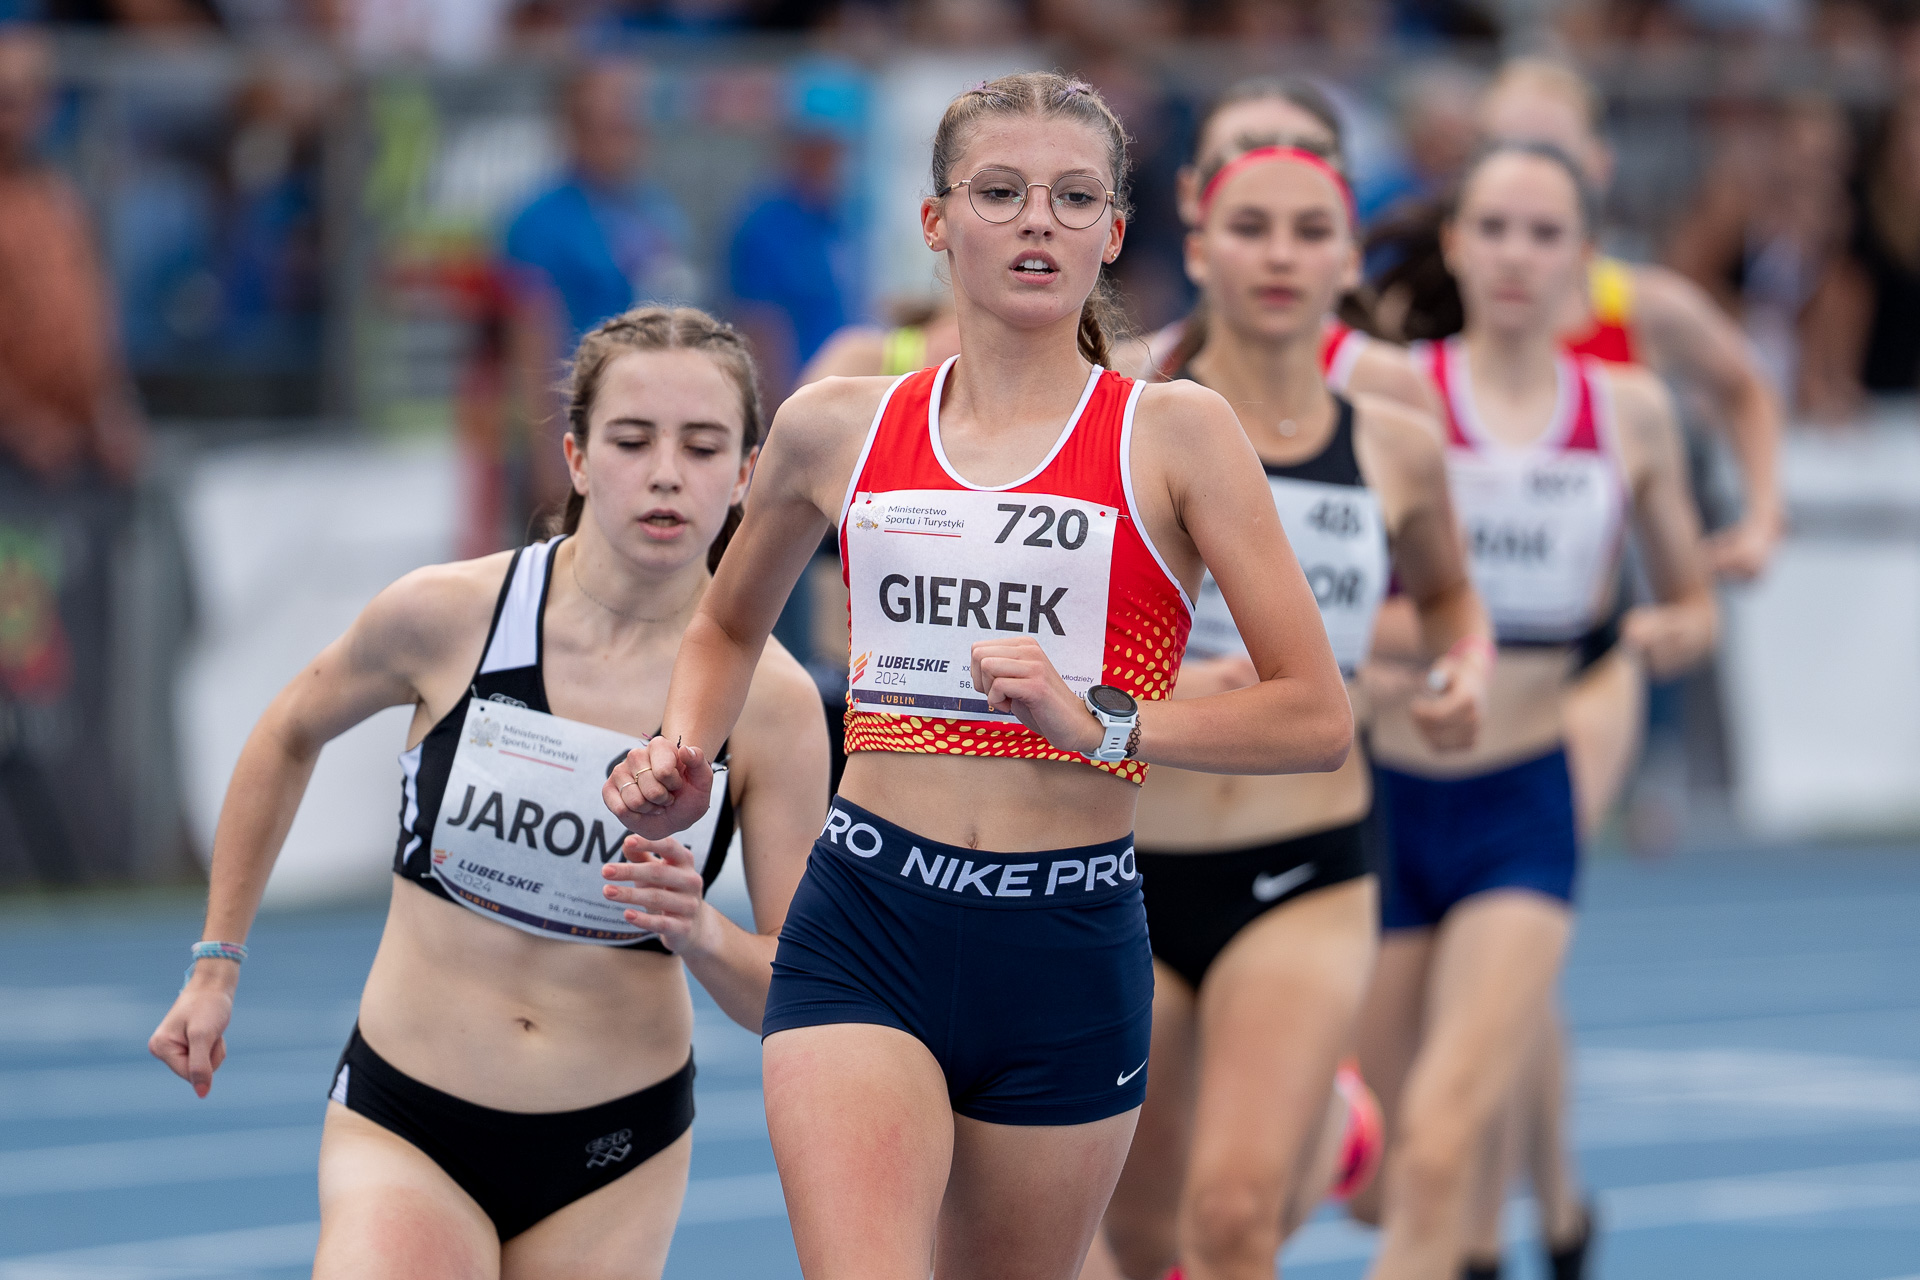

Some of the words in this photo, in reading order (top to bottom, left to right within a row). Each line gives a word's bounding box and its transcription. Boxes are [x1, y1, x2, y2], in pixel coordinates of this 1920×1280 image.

[887, 505, 947, 516] Ministerstwo
[885, 515, 916, 526] Sportu
[917, 517, 922, 525] i
[924, 518, 965, 529] Turystyki
[994, 503, 1089, 550] 720
[879, 573, 1069, 636] GIEREK
[877, 655, 950, 673] LUBELSKIE
[874, 671, 907, 686] 2024
[959, 680, 973, 689] 56.
[881, 694, 915, 705] LUBLIN
[503, 725, 562, 745] Ministerstwo
[501, 736, 531, 750] Sportu
[539, 745, 578, 763] Turystyki
[447, 785, 692, 865] JAROM
[820, 806, 882, 859] RO
[454, 870, 492, 893] 2024
[458, 859, 544, 894] LUBELSKIE
[900, 846, 1039, 897] NIKE
[1044, 846, 1136, 896] PRO
[459, 890, 500, 912] LUBLIN
